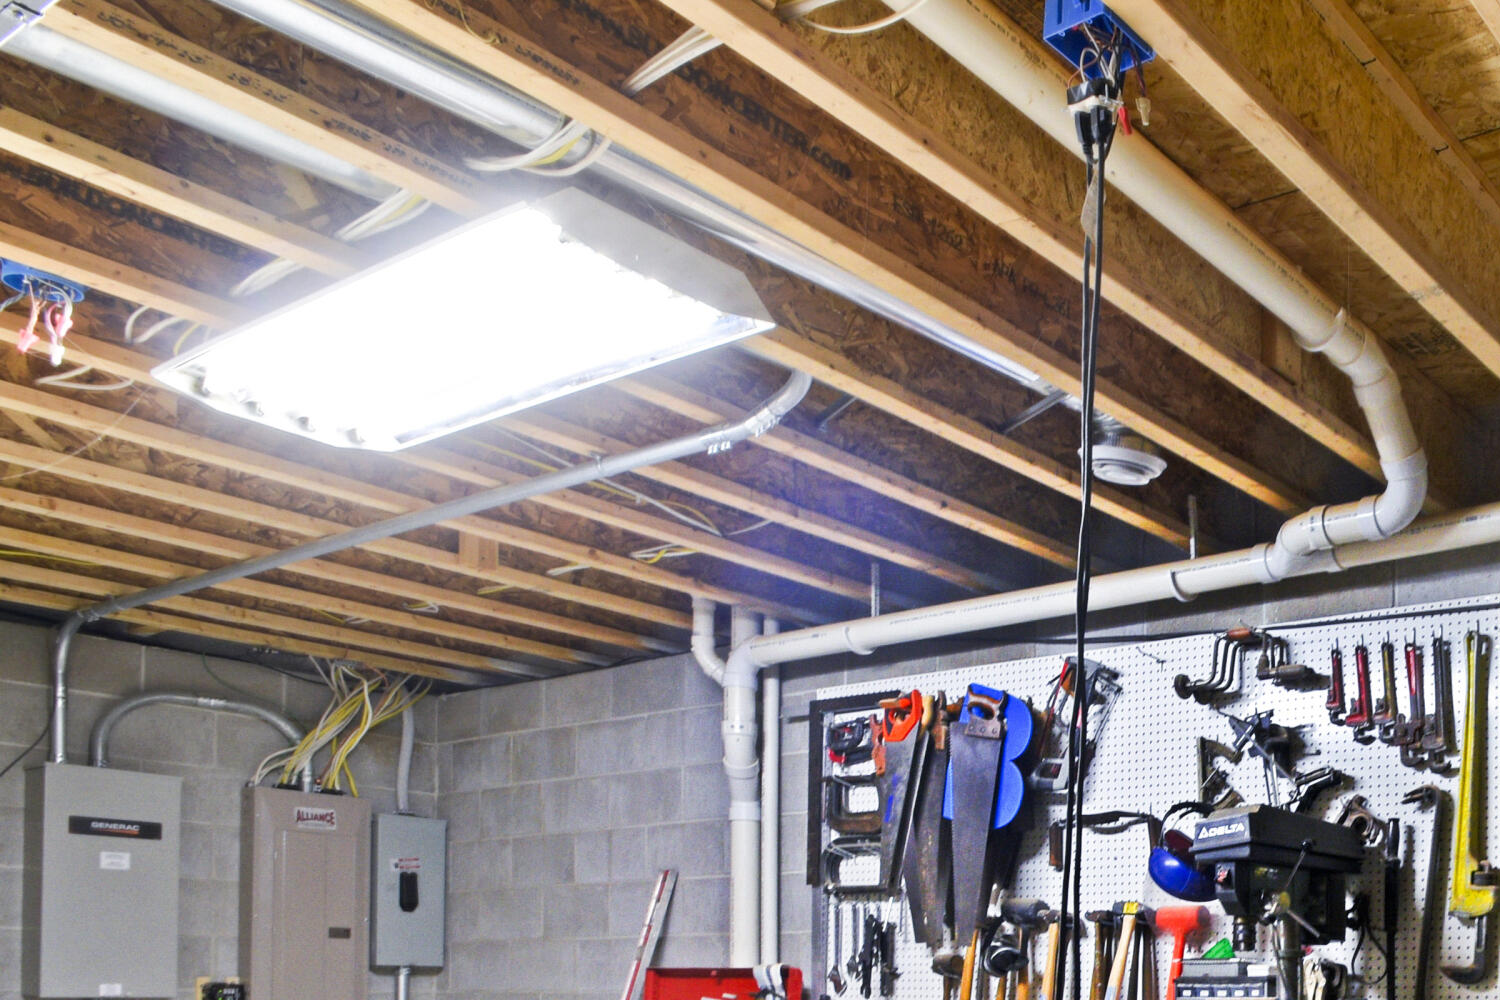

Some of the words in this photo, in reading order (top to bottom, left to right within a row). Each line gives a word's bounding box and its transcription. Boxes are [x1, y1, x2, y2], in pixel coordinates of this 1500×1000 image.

[296, 809, 335, 825] ALLIANCE
[91, 821, 140, 831] GENERAC
[1208, 822, 1245, 838] DELTA
